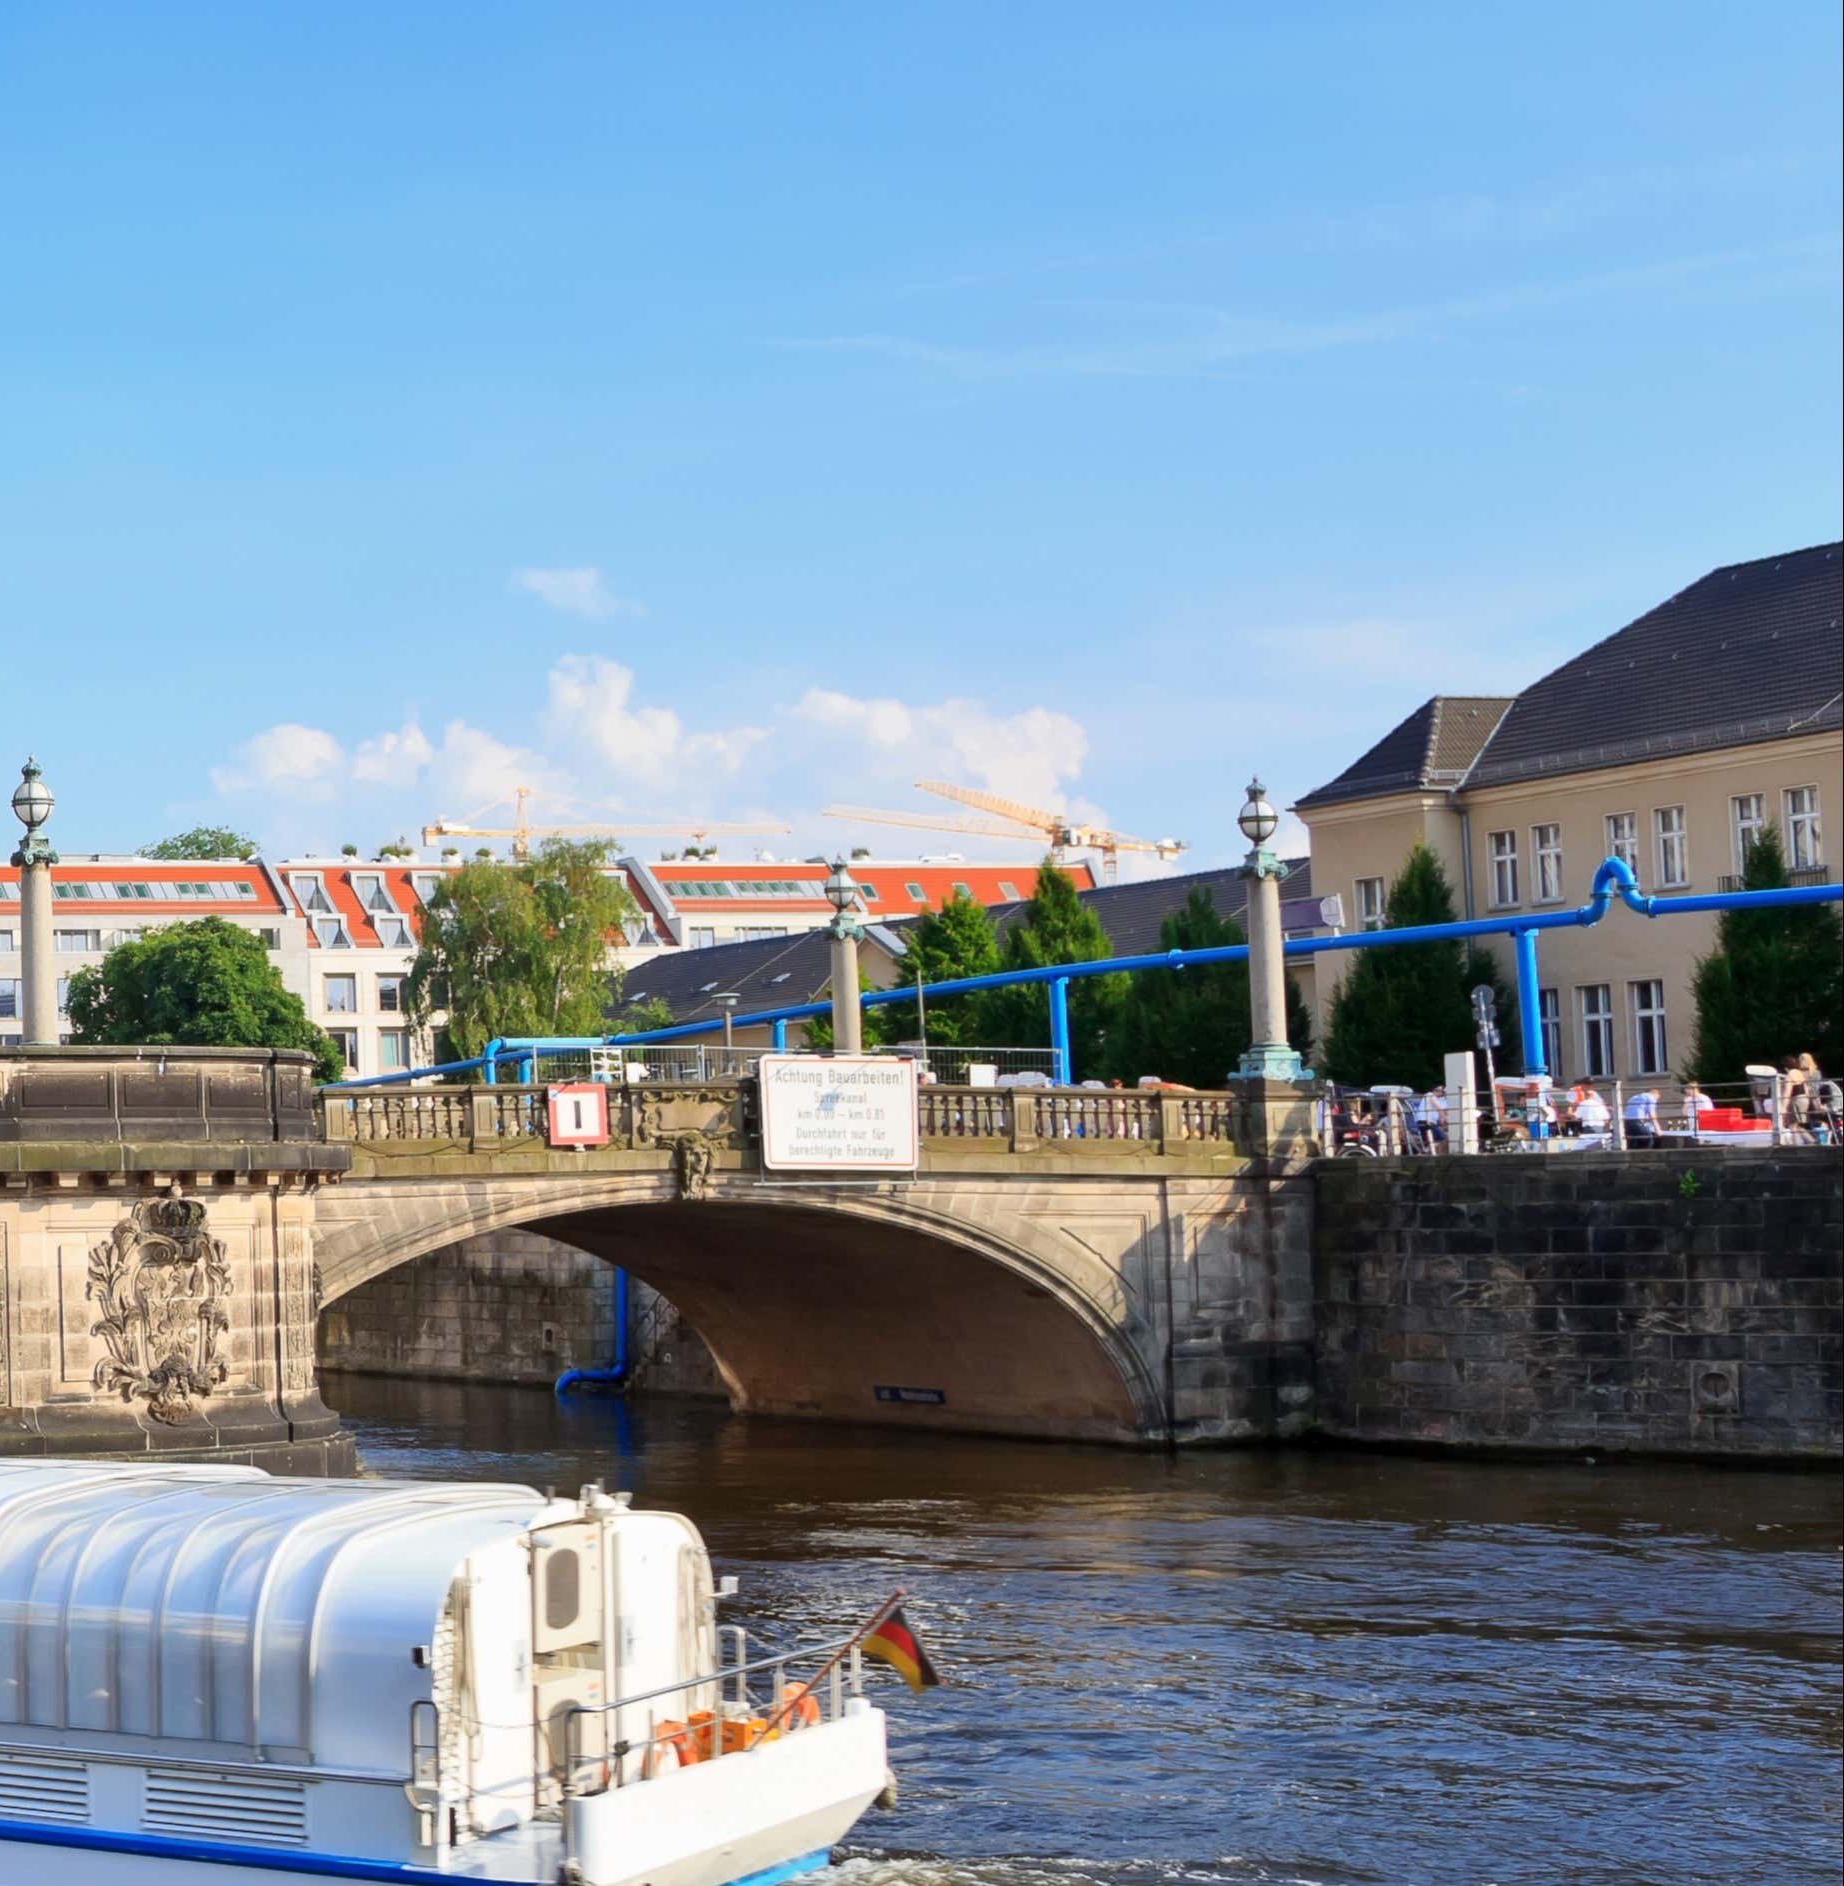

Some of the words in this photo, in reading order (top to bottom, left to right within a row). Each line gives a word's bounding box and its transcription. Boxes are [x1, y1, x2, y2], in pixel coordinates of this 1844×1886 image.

[775, 1069, 823, 1087] Achtung
[828, 1069, 904, 1085] Bauarbeiten!
[798, 1107, 812, 1120] km
[848, 1107, 863, 1120] km
[796, 1127, 847, 1140] Durchfahrt
[852, 1130, 866, 1140] nur
[872, 1127, 887, 1140] für
[789, 1144, 842, 1159] berechtigte
[846, 1144, 894, 1160] Fahrzeuge
